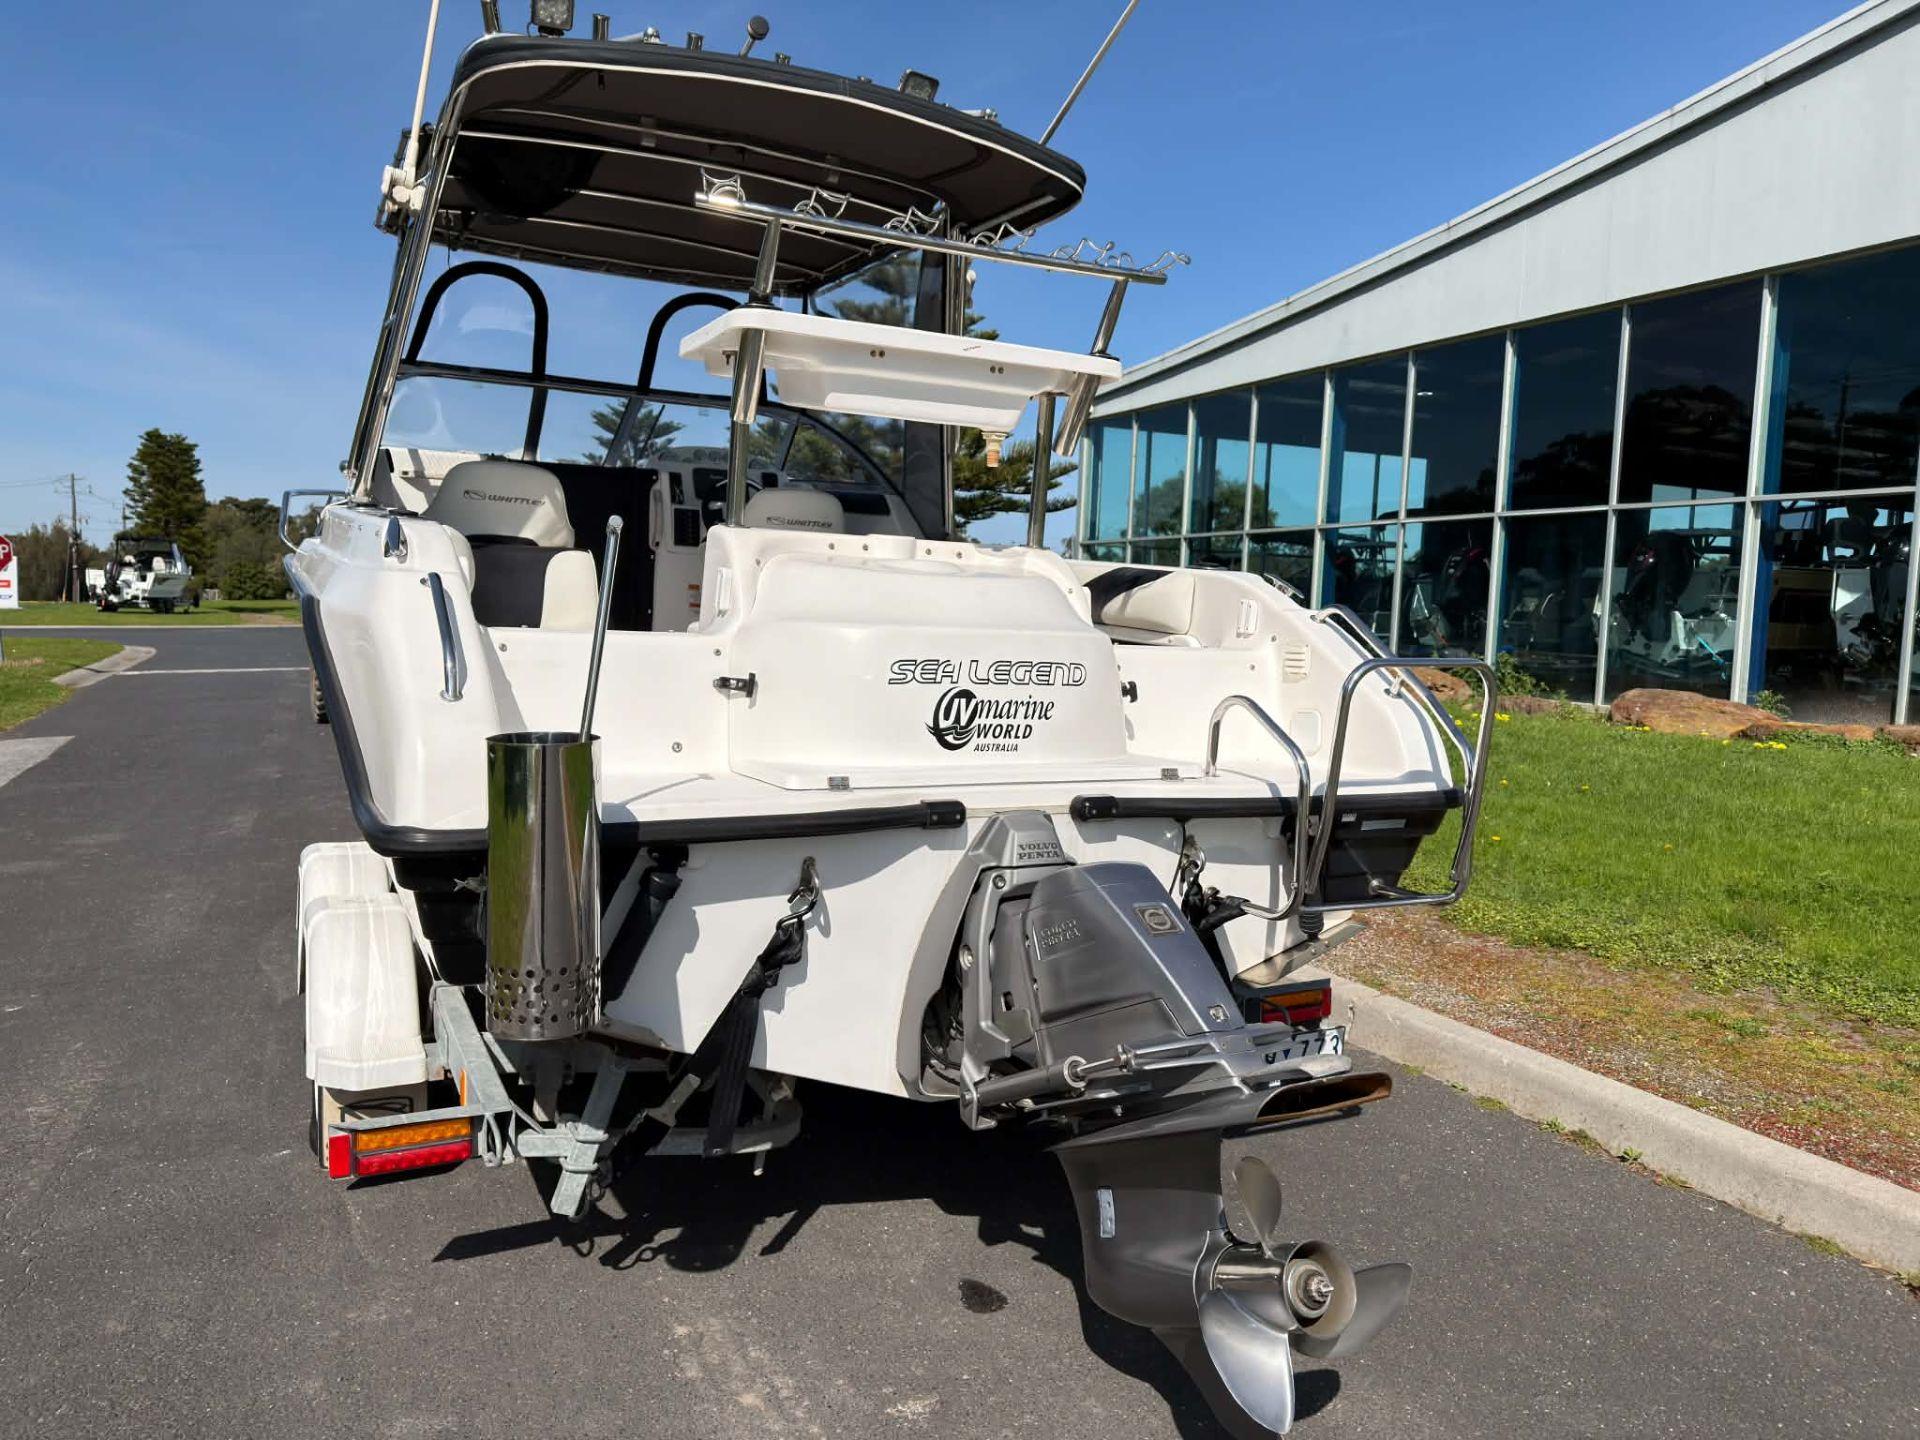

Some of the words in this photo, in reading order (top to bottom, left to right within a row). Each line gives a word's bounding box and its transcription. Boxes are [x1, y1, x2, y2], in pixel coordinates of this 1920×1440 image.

[888, 659, 963, 685] SEA
[968, 659, 1088, 687] LEGEND
[977, 694, 1055, 721] marine
[976, 723, 1034, 740] WORLD
[973, 743, 1019, 753] AUSTRALIA
[1018, 842, 1058, 851] VOLVO
[1017, 850, 1061, 860] PENTA
